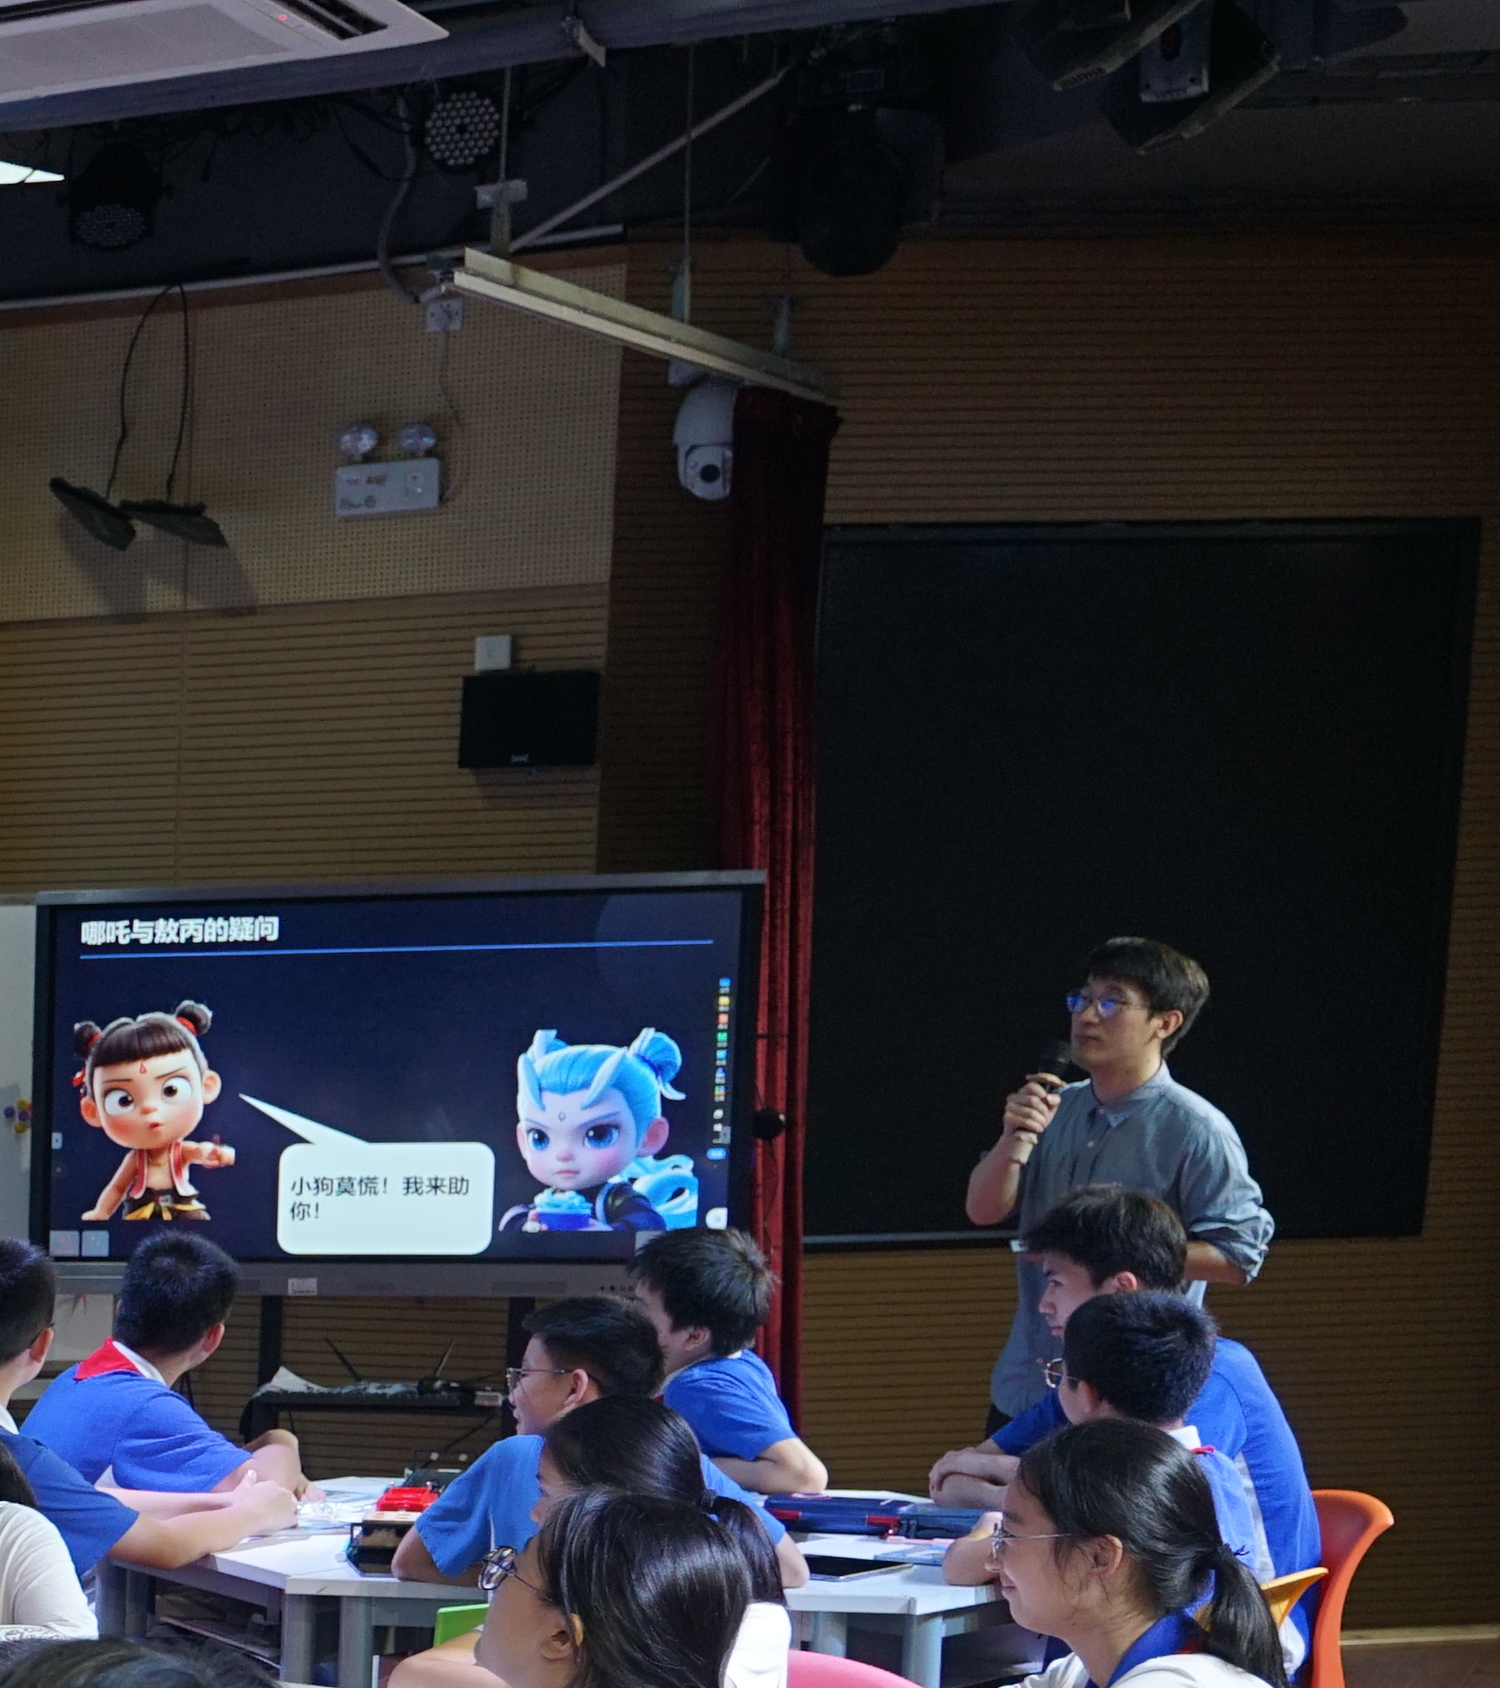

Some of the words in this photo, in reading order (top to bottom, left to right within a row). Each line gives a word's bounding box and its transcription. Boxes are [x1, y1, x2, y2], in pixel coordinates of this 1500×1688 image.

[80, 914, 280, 946] 哪吒与敖丙的疑问
[290, 1175, 470, 1198] 小狗莫慌！我来助
[289, 1201, 320, 1221] 你！
